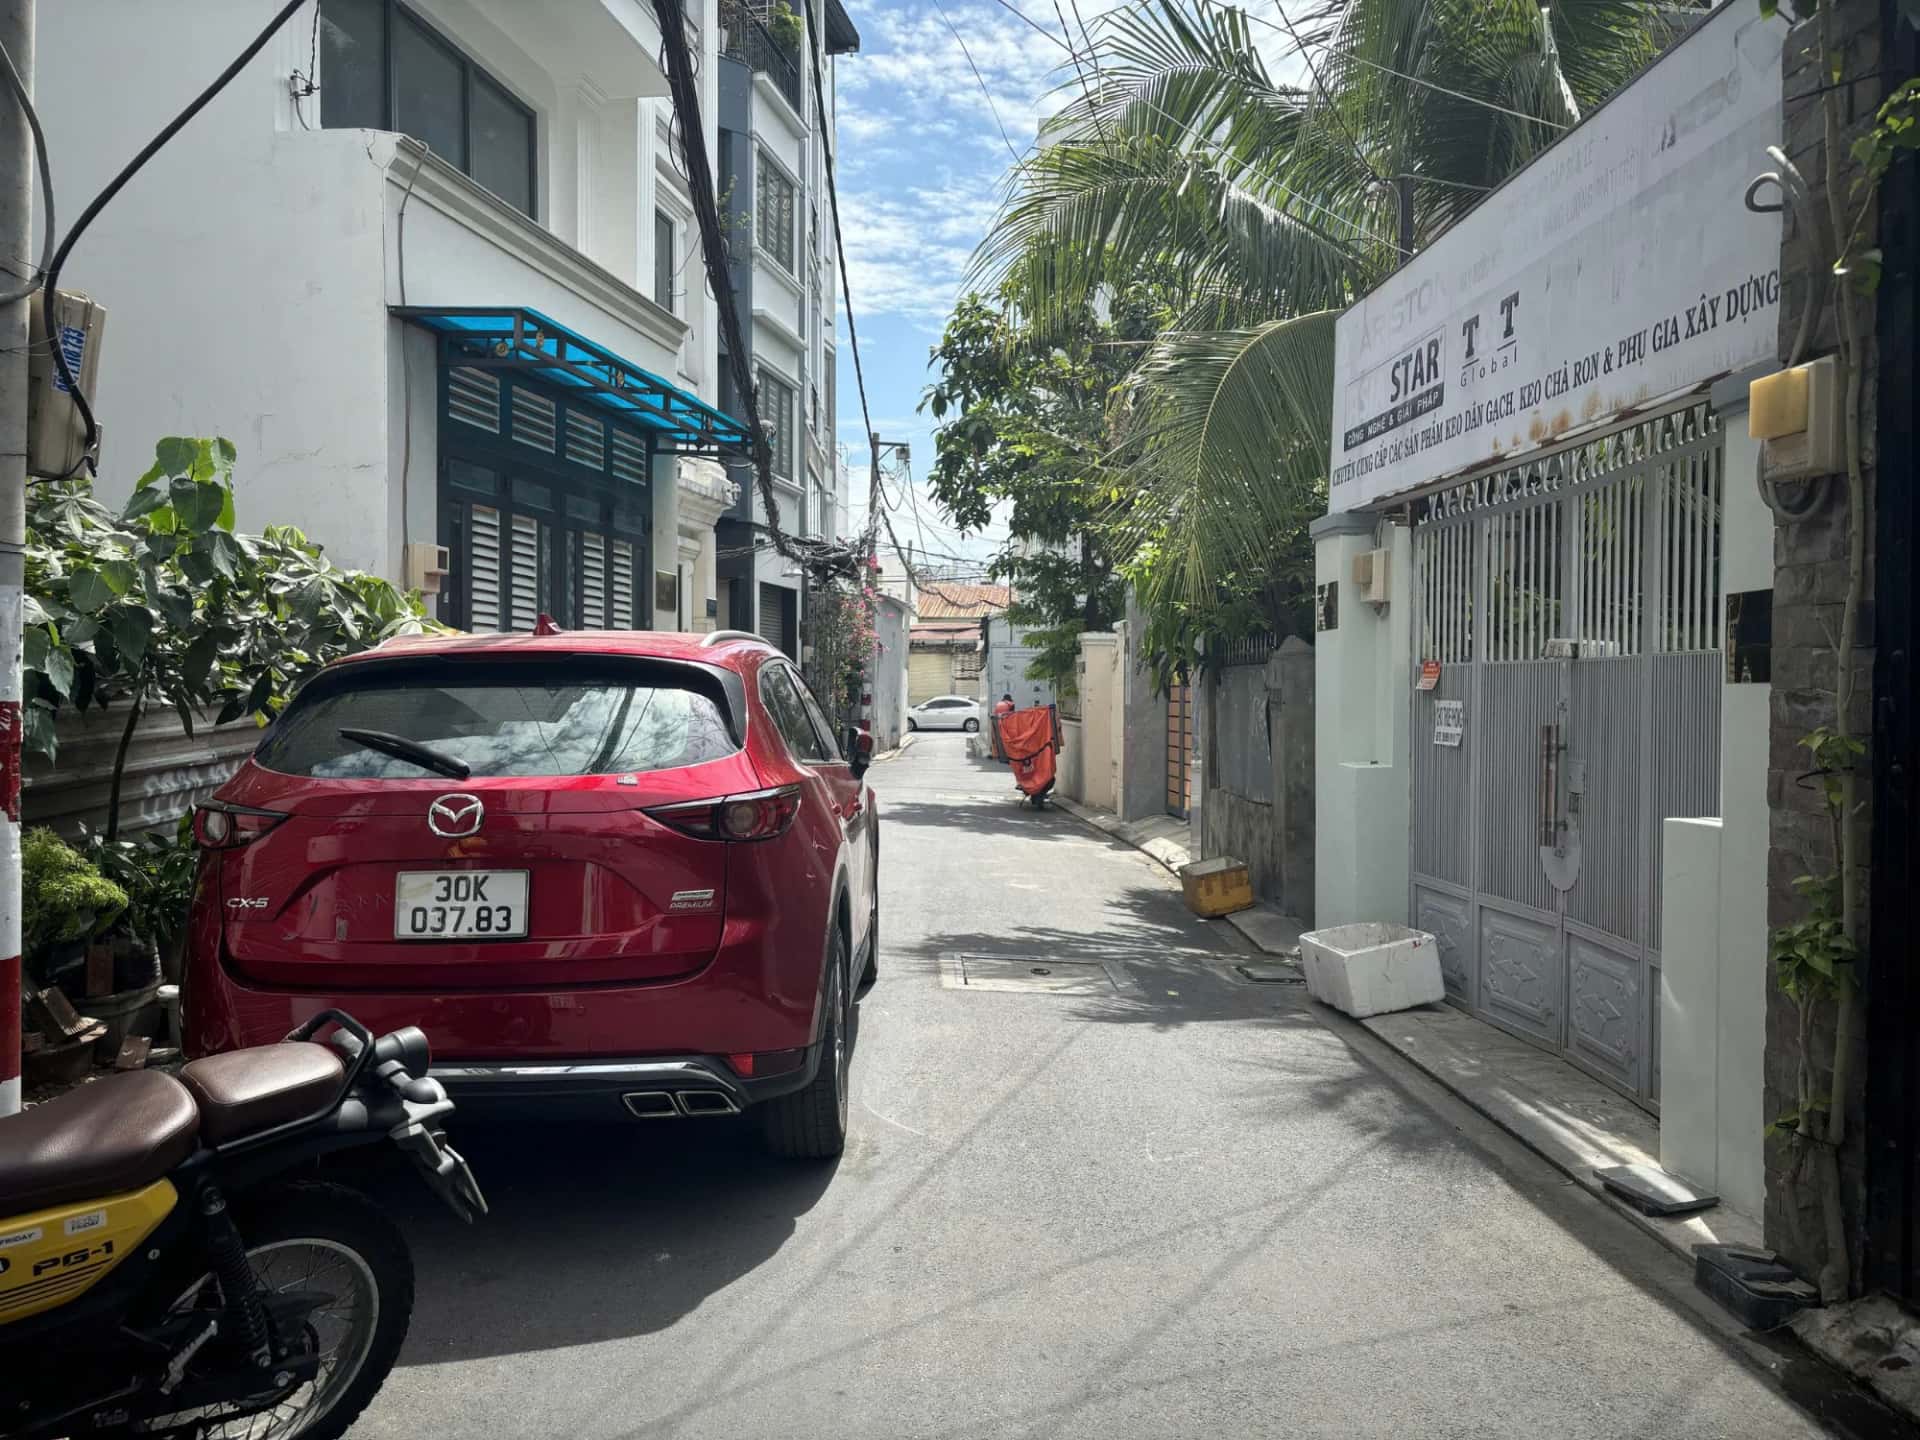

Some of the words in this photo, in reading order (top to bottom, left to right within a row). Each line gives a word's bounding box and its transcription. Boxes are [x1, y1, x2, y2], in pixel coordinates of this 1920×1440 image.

[1463, 314, 1480, 359] T
[1500, 290, 1520, 339] T
[1356, 453, 1374, 479] CUNG
[1445, 413, 1463, 441] KEO
[1519, 379, 1542, 412] KEO
[1572, 351, 1600, 389] RON
[1603, 346, 1613, 375] &
[1617, 329, 1648, 367] PHỤ
[1652, 315, 1681, 353] GIA
[1684, 293, 1721, 341] XÂY
[1726, 269, 1780, 324] DỰNG
[1390, 338, 1440, 403] STAR
[1460, 346, 1518, 388] Global
[226, 897, 270, 908] CX-5
[435, 875, 489, 902] 30K
[411, 906, 512, 933] 037.83
[33, 1240, 113, 1276] PG-1
